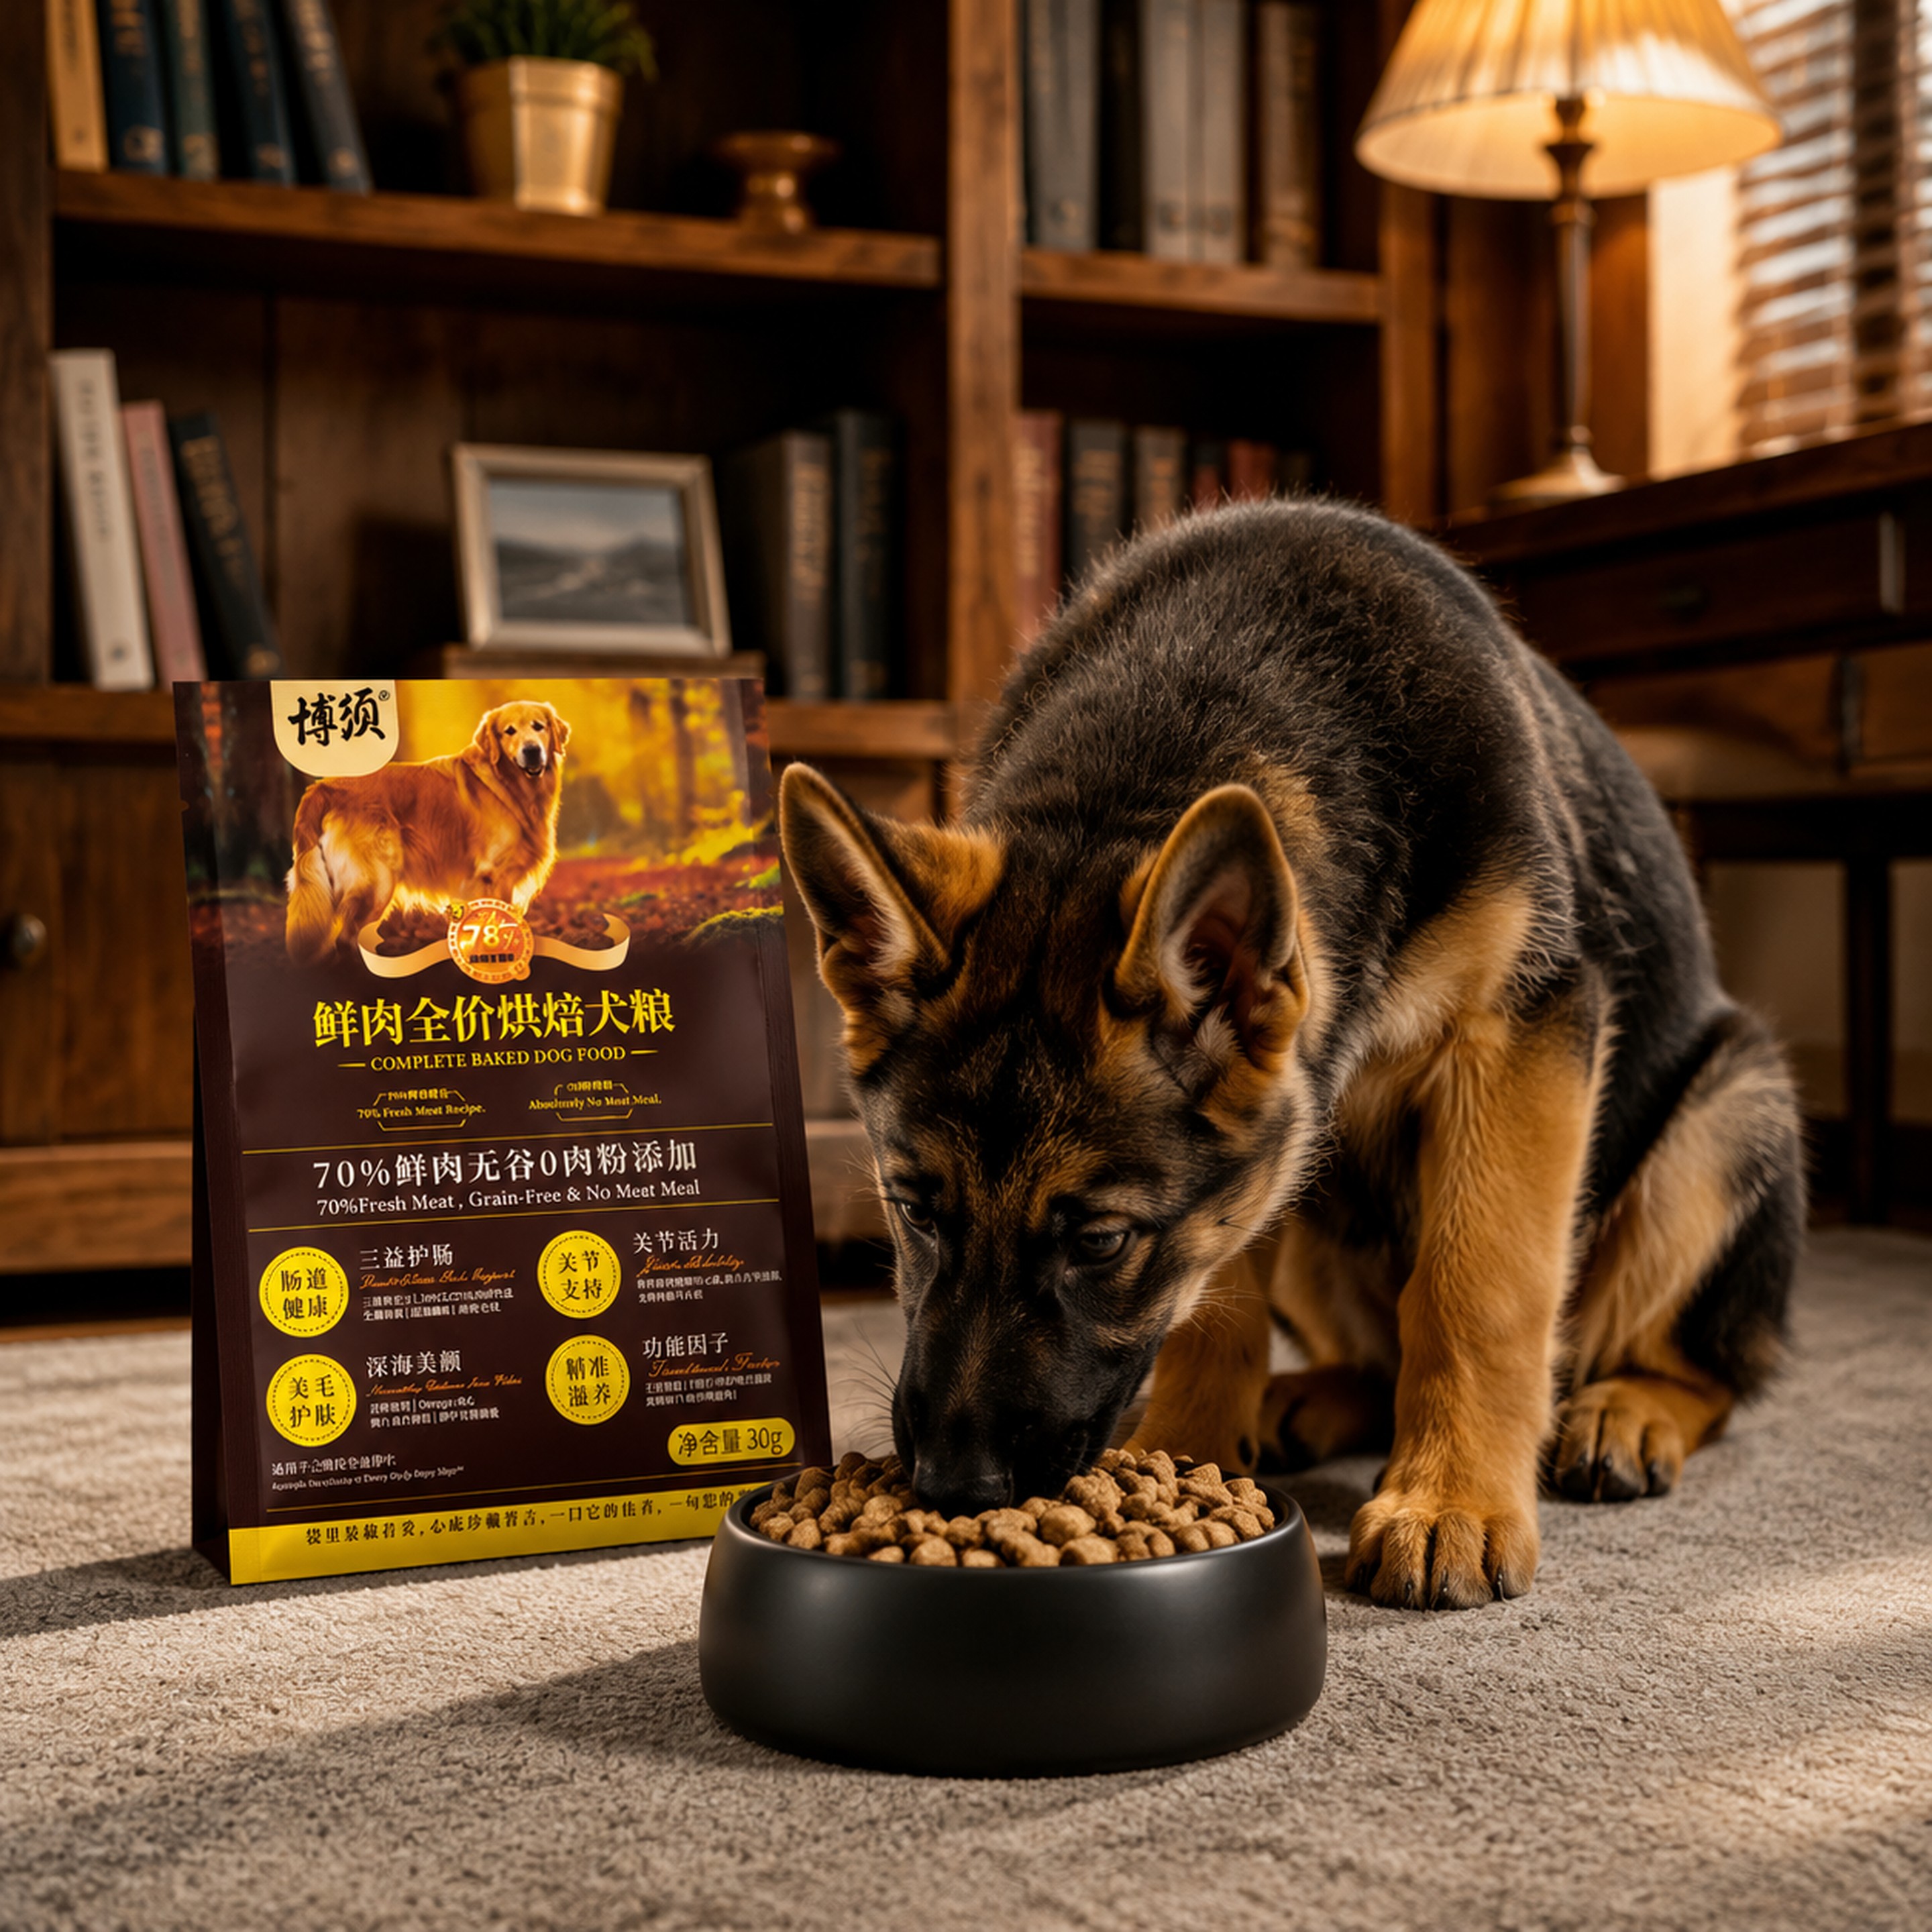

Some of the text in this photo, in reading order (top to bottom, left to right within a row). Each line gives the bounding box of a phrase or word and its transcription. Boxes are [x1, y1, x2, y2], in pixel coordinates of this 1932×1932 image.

[313, 988, 676, 1048] 鲜肉全价烘焙犬粮
[370, 1046, 627, 1072] COMPLETE BAKED DOG FOOD
[313, 1138, 698, 1189] 70%鲜肉无谷0肉粉添加
[468, 1189, 562, 1208] Grain-Free
[566, 1186, 582, 1202] &
[586, 1184, 611, 1200] No
[616, 1183, 656, 1199] Meat
[661, 1179, 701, 1197] Meal
[633, 1228, 719, 1254] 关节活力
[560, 1277, 603, 1302] 支持
[642, 1332, 729, 1360] 功能因子
[678, 1427, 784, 1458] 净含量 30g
